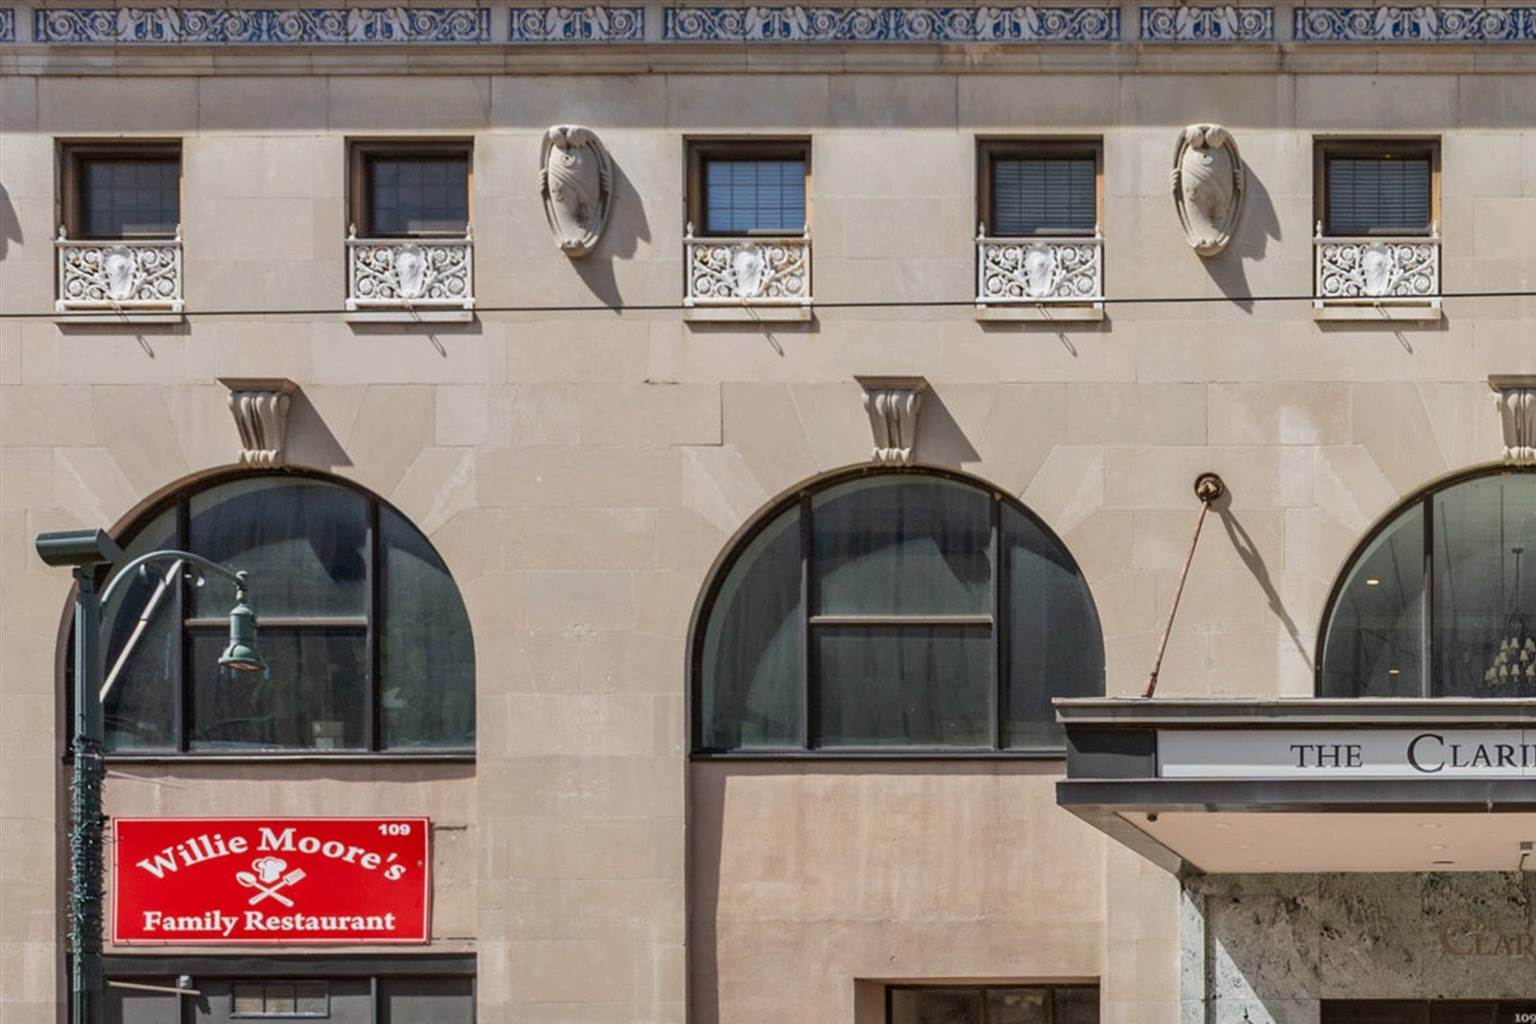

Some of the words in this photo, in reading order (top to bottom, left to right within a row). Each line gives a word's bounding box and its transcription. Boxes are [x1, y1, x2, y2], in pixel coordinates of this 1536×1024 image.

[1290, 744, 1363, 768] THE
[378, 824, 411, 836] 109
[136, 832, 248, 879] Willie
[256, 827, 407, 881] Moore's
[143, 911, 239, 937] Family
[243, 911, 396, 931] Restaurant
